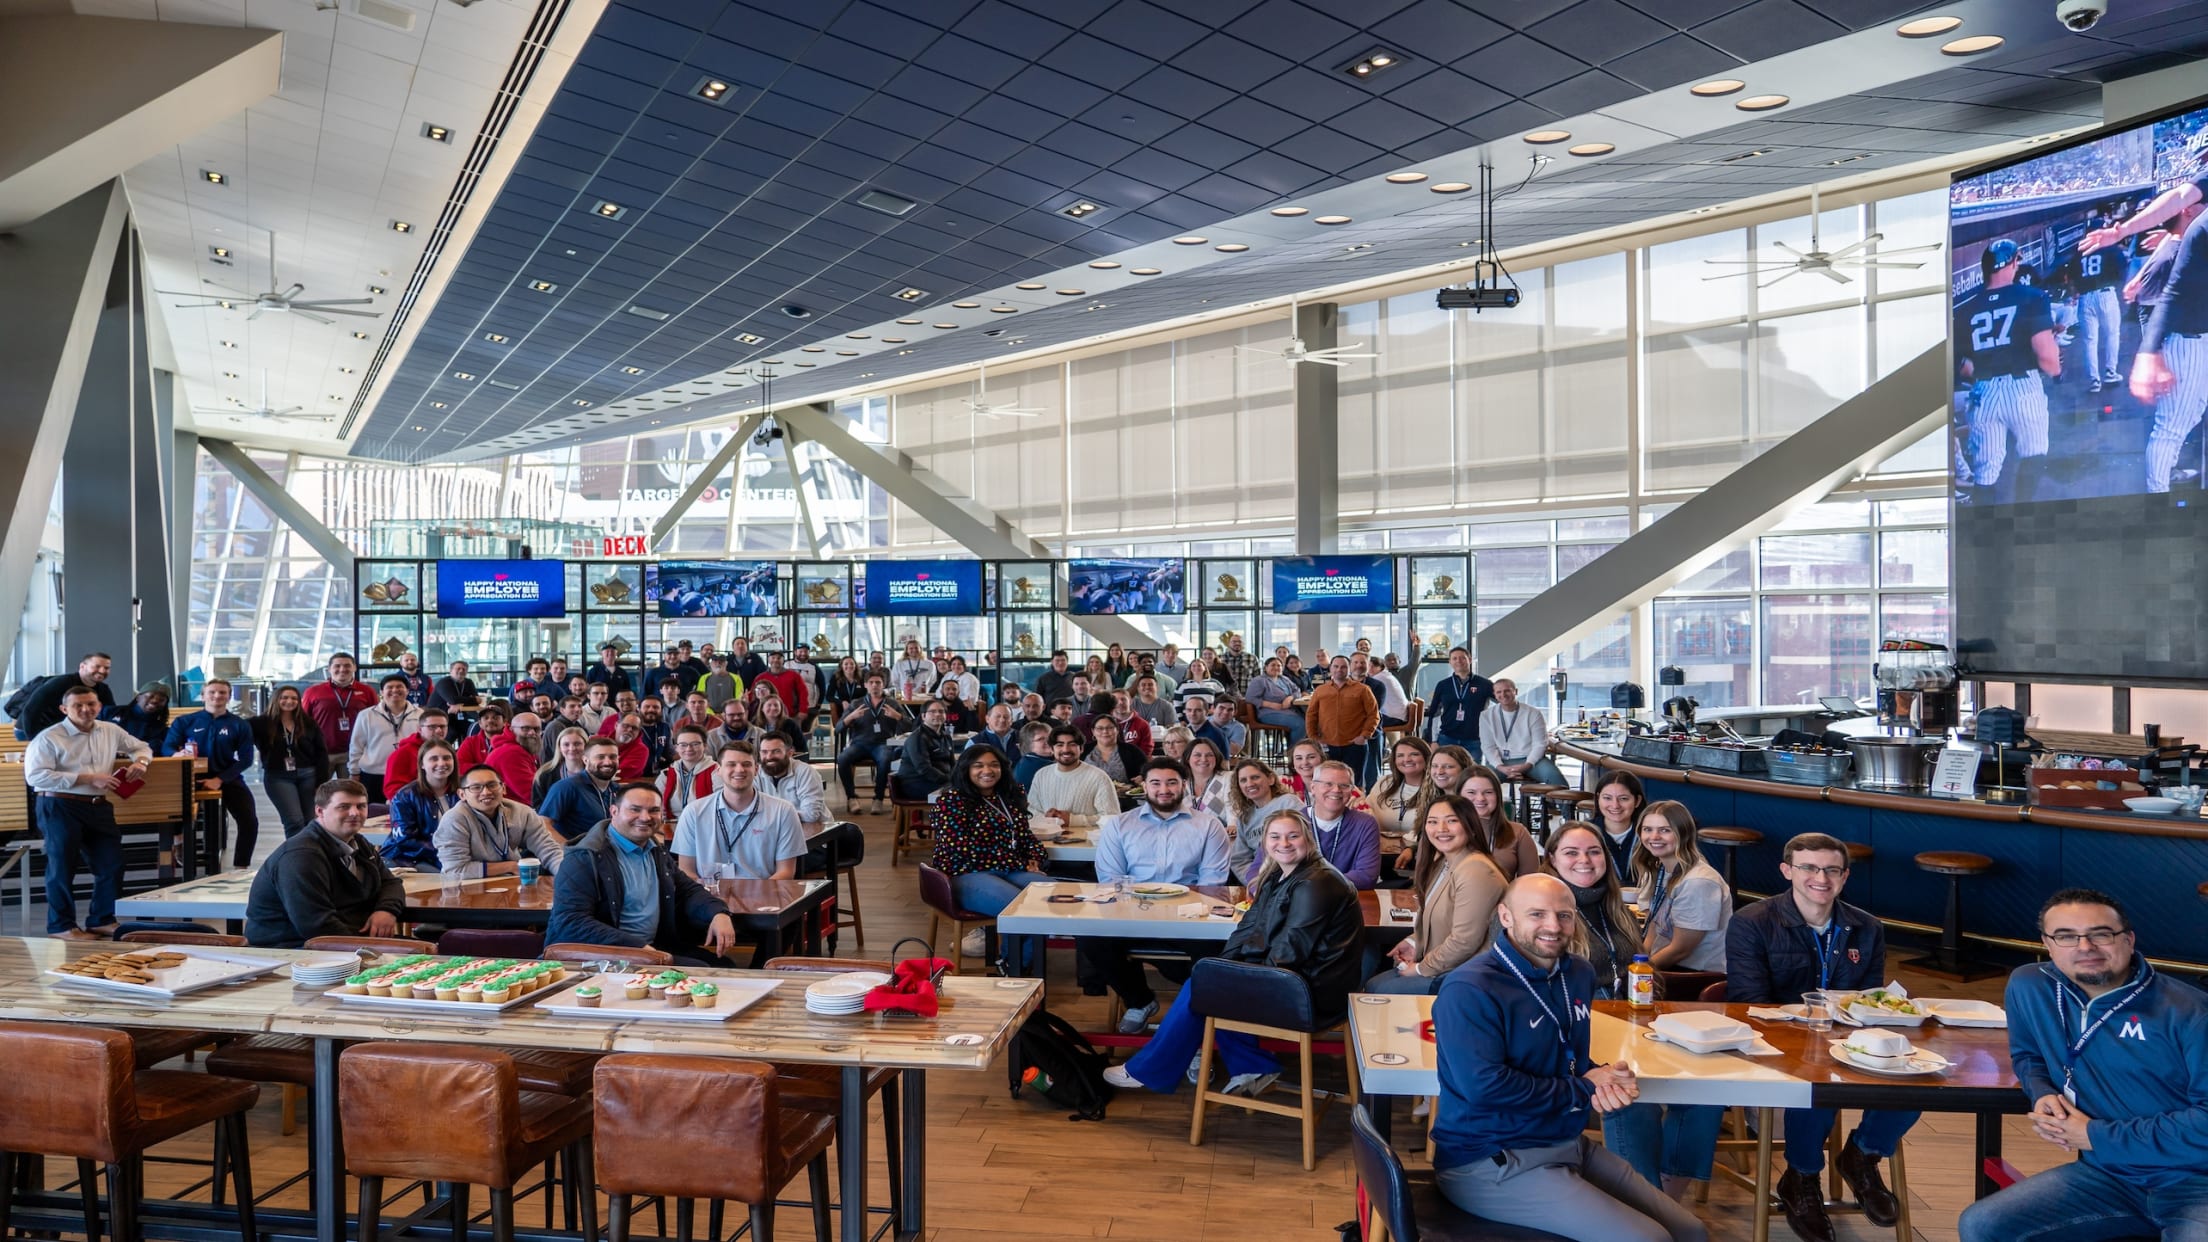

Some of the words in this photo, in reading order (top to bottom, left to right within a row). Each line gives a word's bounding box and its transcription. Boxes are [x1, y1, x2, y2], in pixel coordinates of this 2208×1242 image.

[2081, 255, 2101, 276] 18
[1970, 305, 2017, 351] 27
[618, 488, 690, 501] TARGE
[603, 536, 647, 556] DECK
[464, 586, 539, 594] EMPLOYEE
[889, 585, 958, 593] EMPLOYEE
[1297, 581, 1368, 589] EMPLOYEE
[1574, 1003, 1591, 1021] M
[2119, 1021, 2146, 1041] M
